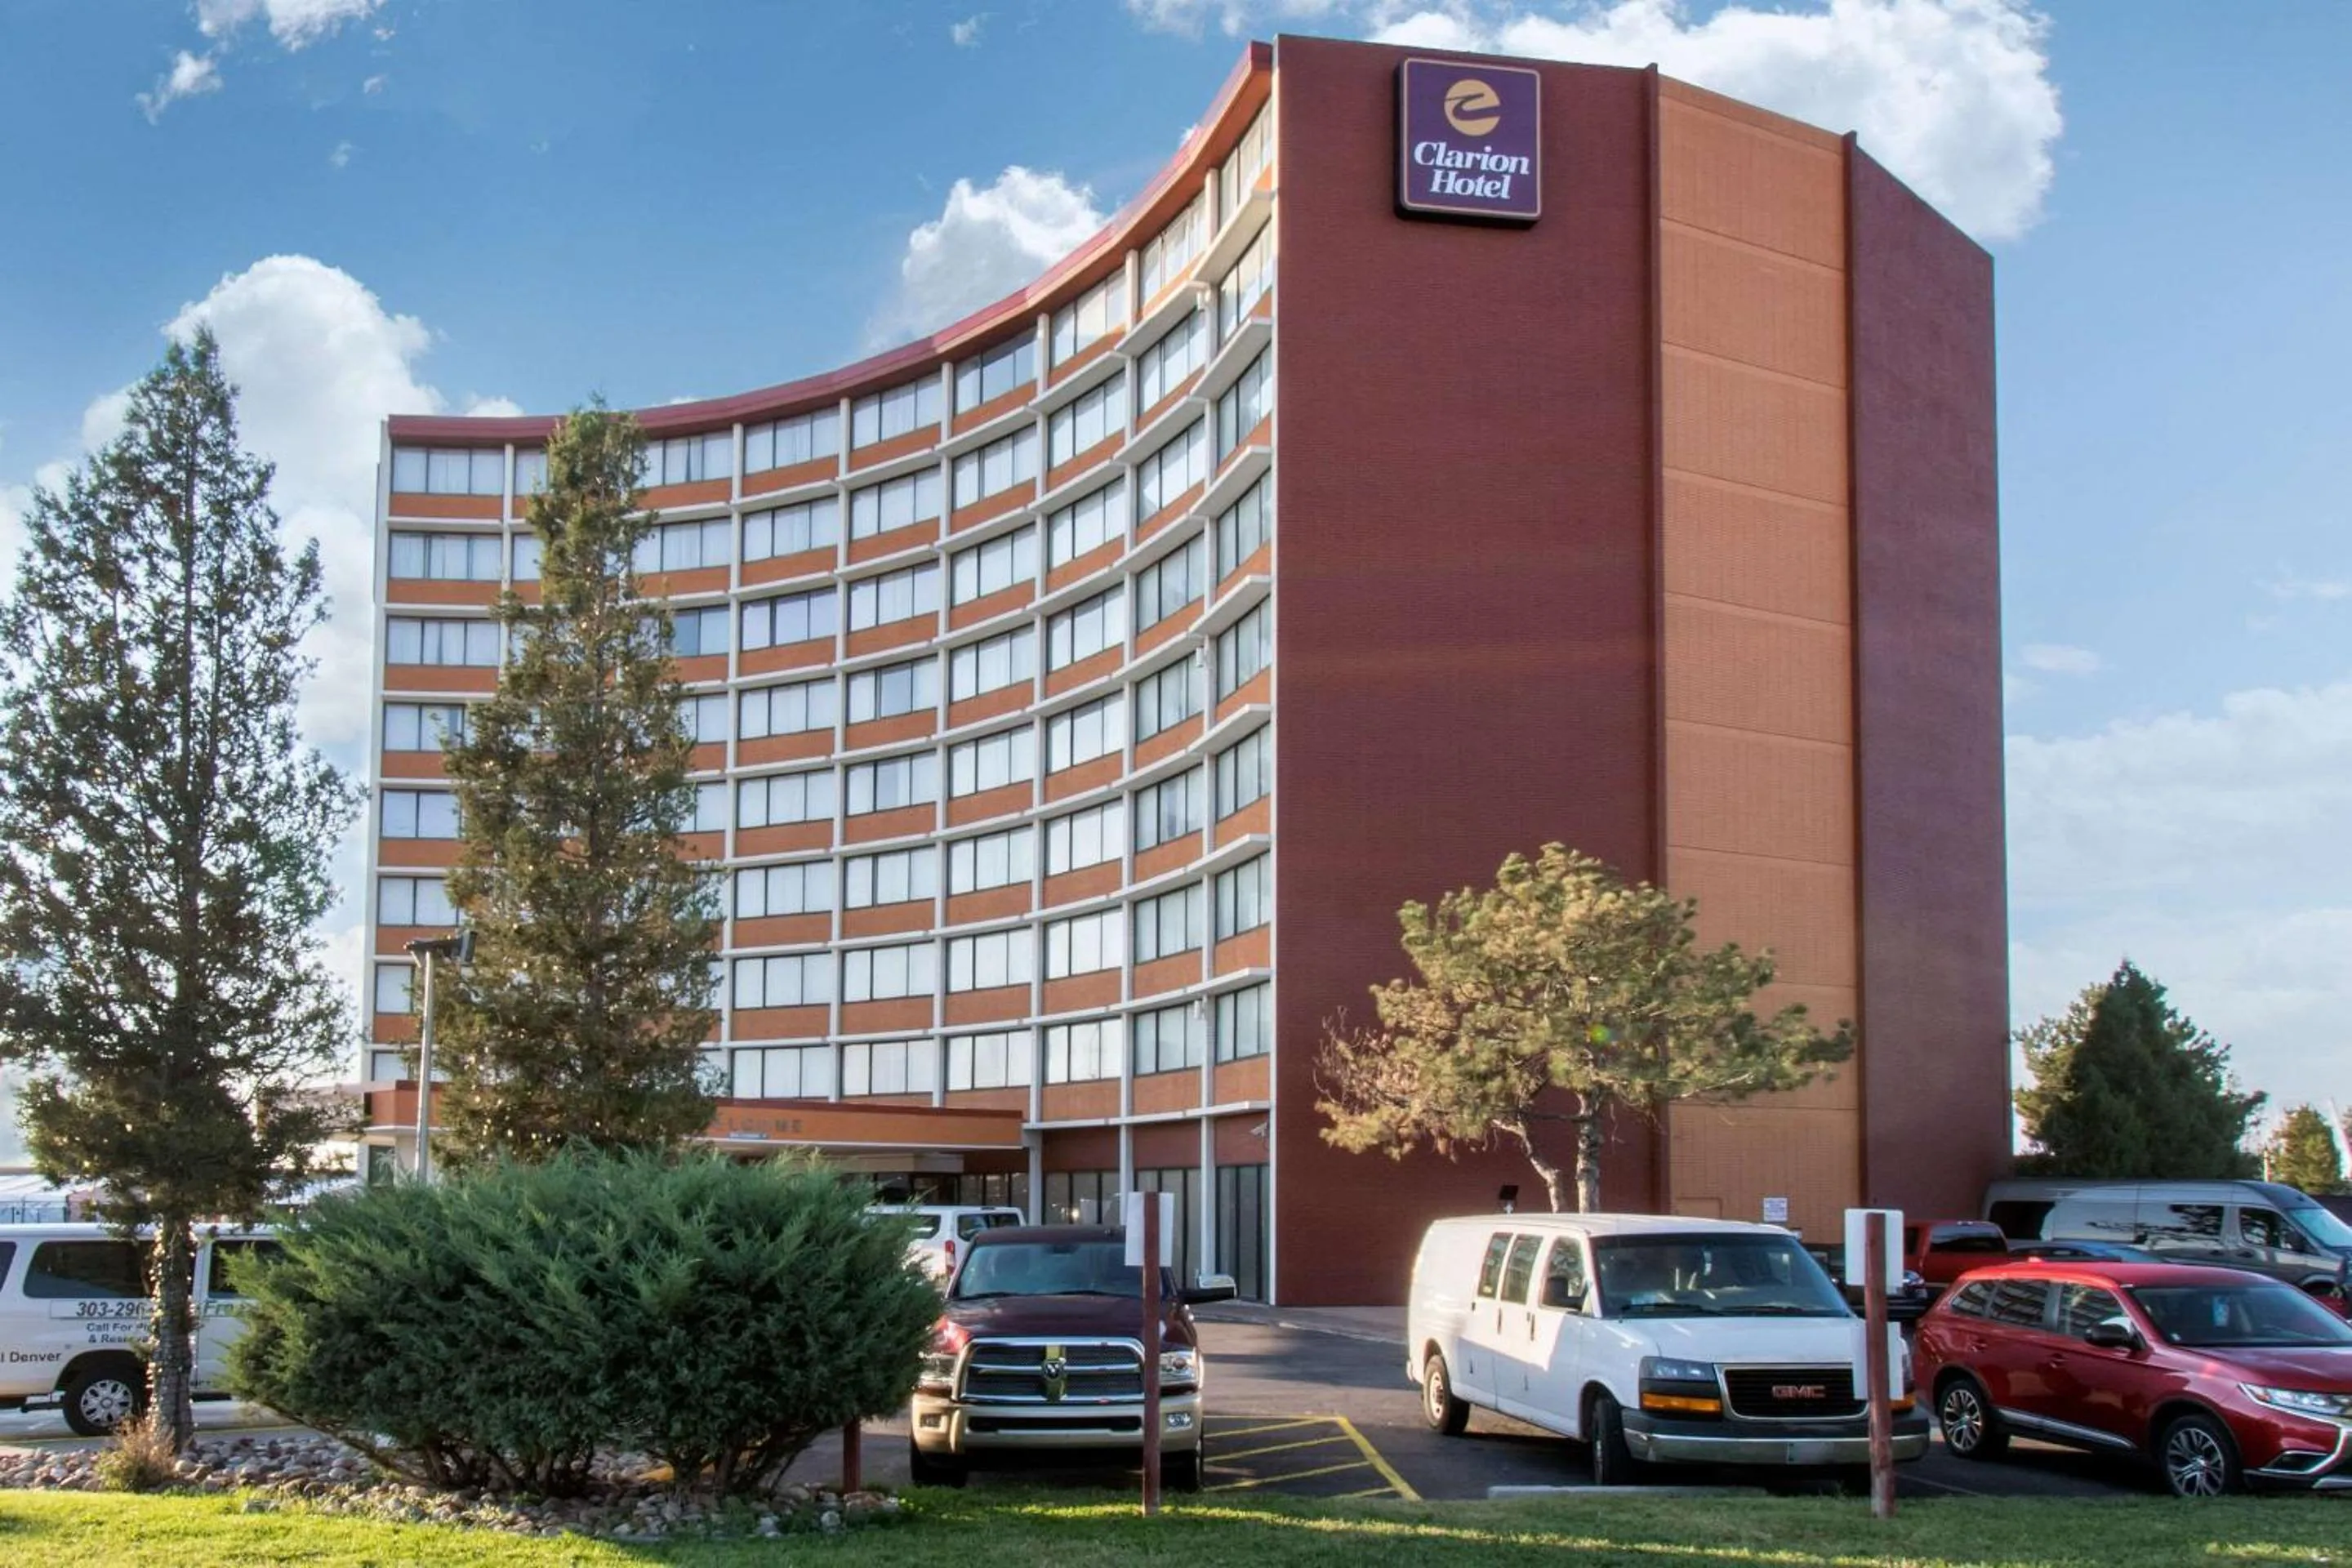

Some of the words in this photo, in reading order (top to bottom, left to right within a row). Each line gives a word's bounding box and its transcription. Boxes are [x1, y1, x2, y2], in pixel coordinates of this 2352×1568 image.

[1414, 141, 1529, 174] Clarion
[1430, 169, 1511, 198] Hotel
[87, 1322, 109, 1332] Call
[113, 1322, 133, 1332] For
[10, 1351, 62, 1363] Denver
[1772, 1385, 1825, 1398] GMC
